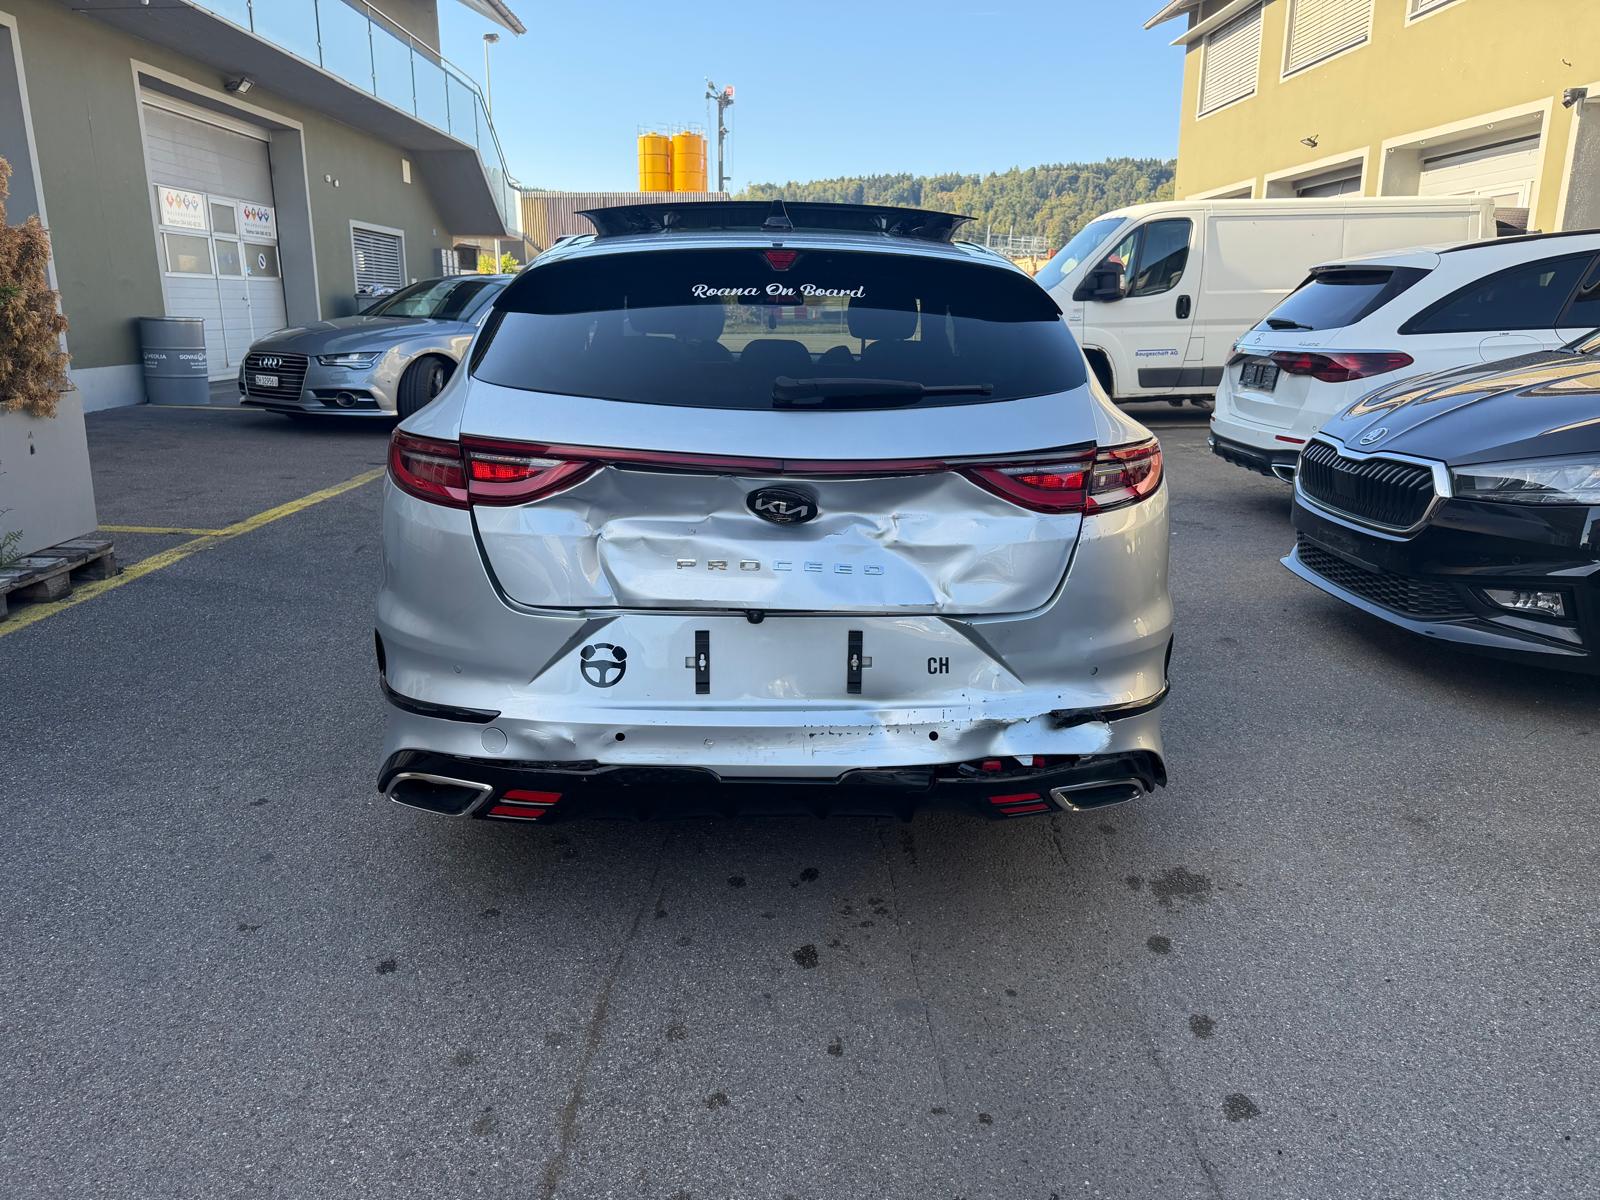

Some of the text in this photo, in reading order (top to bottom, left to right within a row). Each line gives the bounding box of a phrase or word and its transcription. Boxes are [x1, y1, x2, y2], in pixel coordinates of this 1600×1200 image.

[692, 283, 866, 298] Roana On Board
[755, 499, 808, 518] KIA
[676, 558, 885, 576] PROCEED
[927, 656, 950, 675] CH
